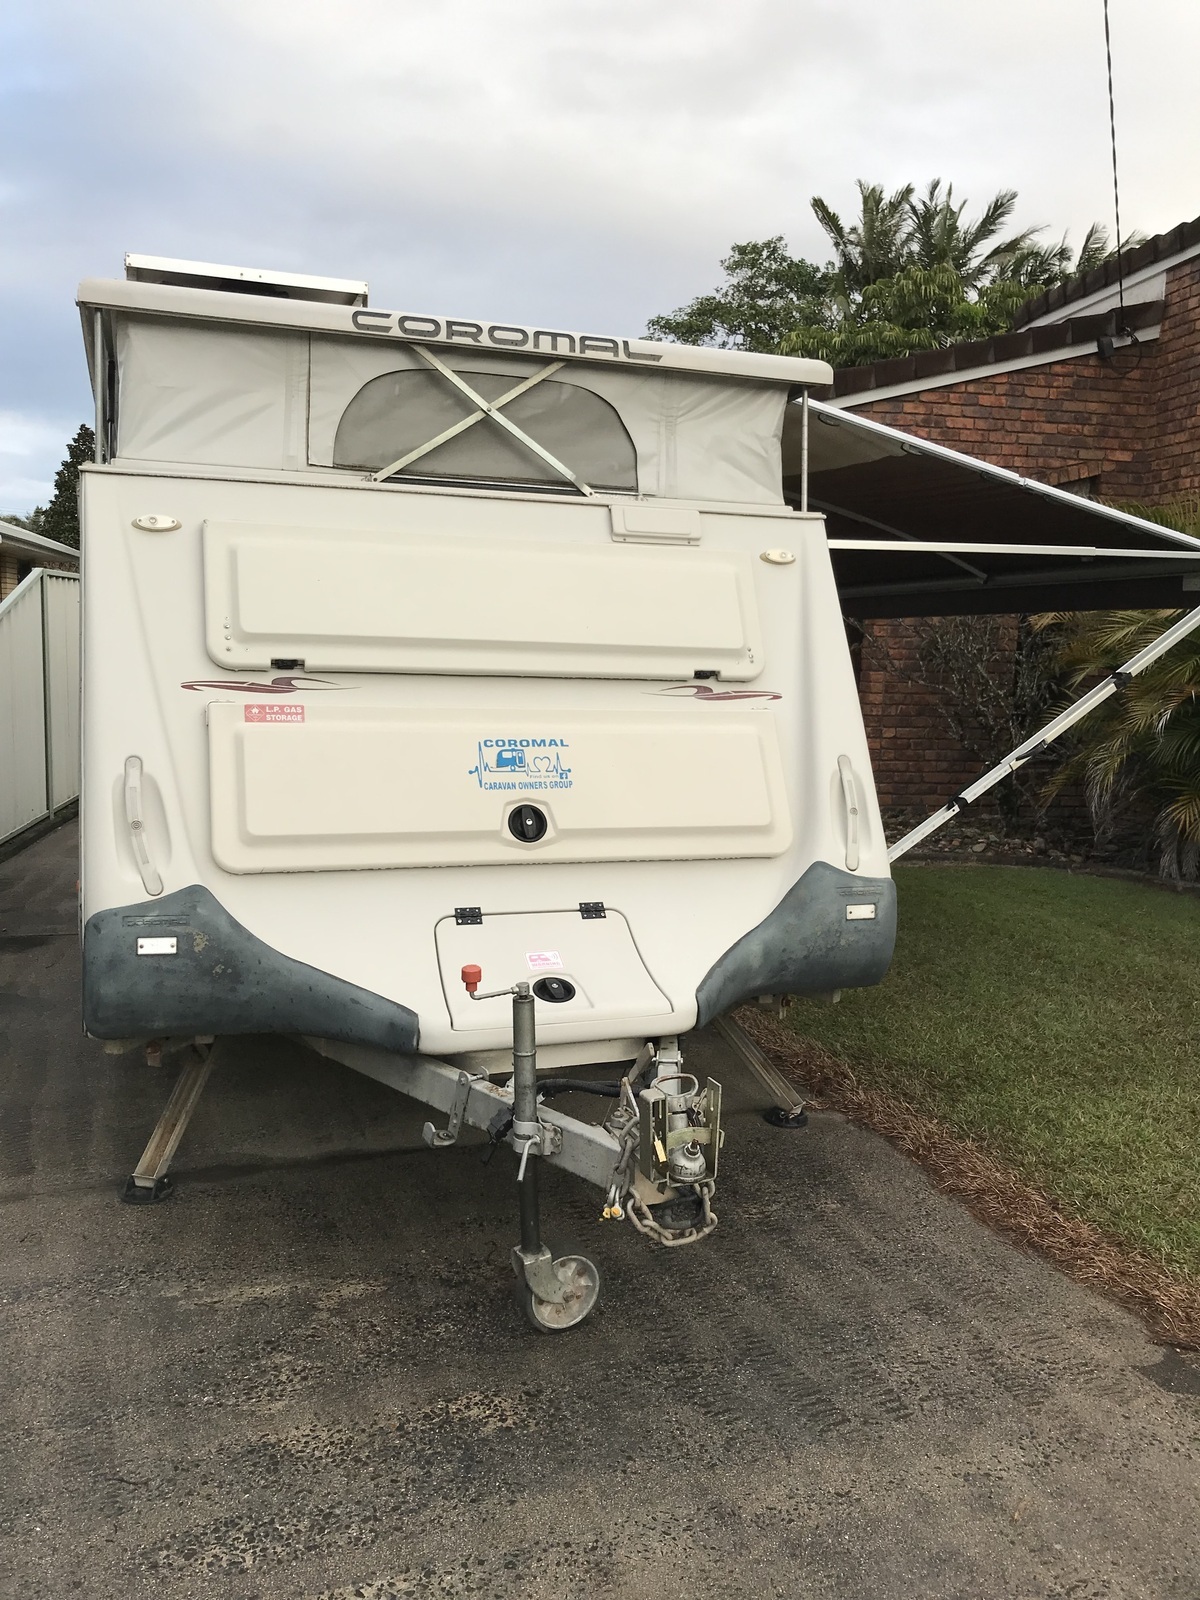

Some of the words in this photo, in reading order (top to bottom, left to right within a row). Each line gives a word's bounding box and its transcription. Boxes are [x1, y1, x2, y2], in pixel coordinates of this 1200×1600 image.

[351, 310, 664, 363] COROMAL
[483, 739, 569, 748] COROMAL
[483, 781, 517, 791] CARAVAN
[518, 780, 549, 790] OWNERS
[549, 780, 574, 789] GROUP
